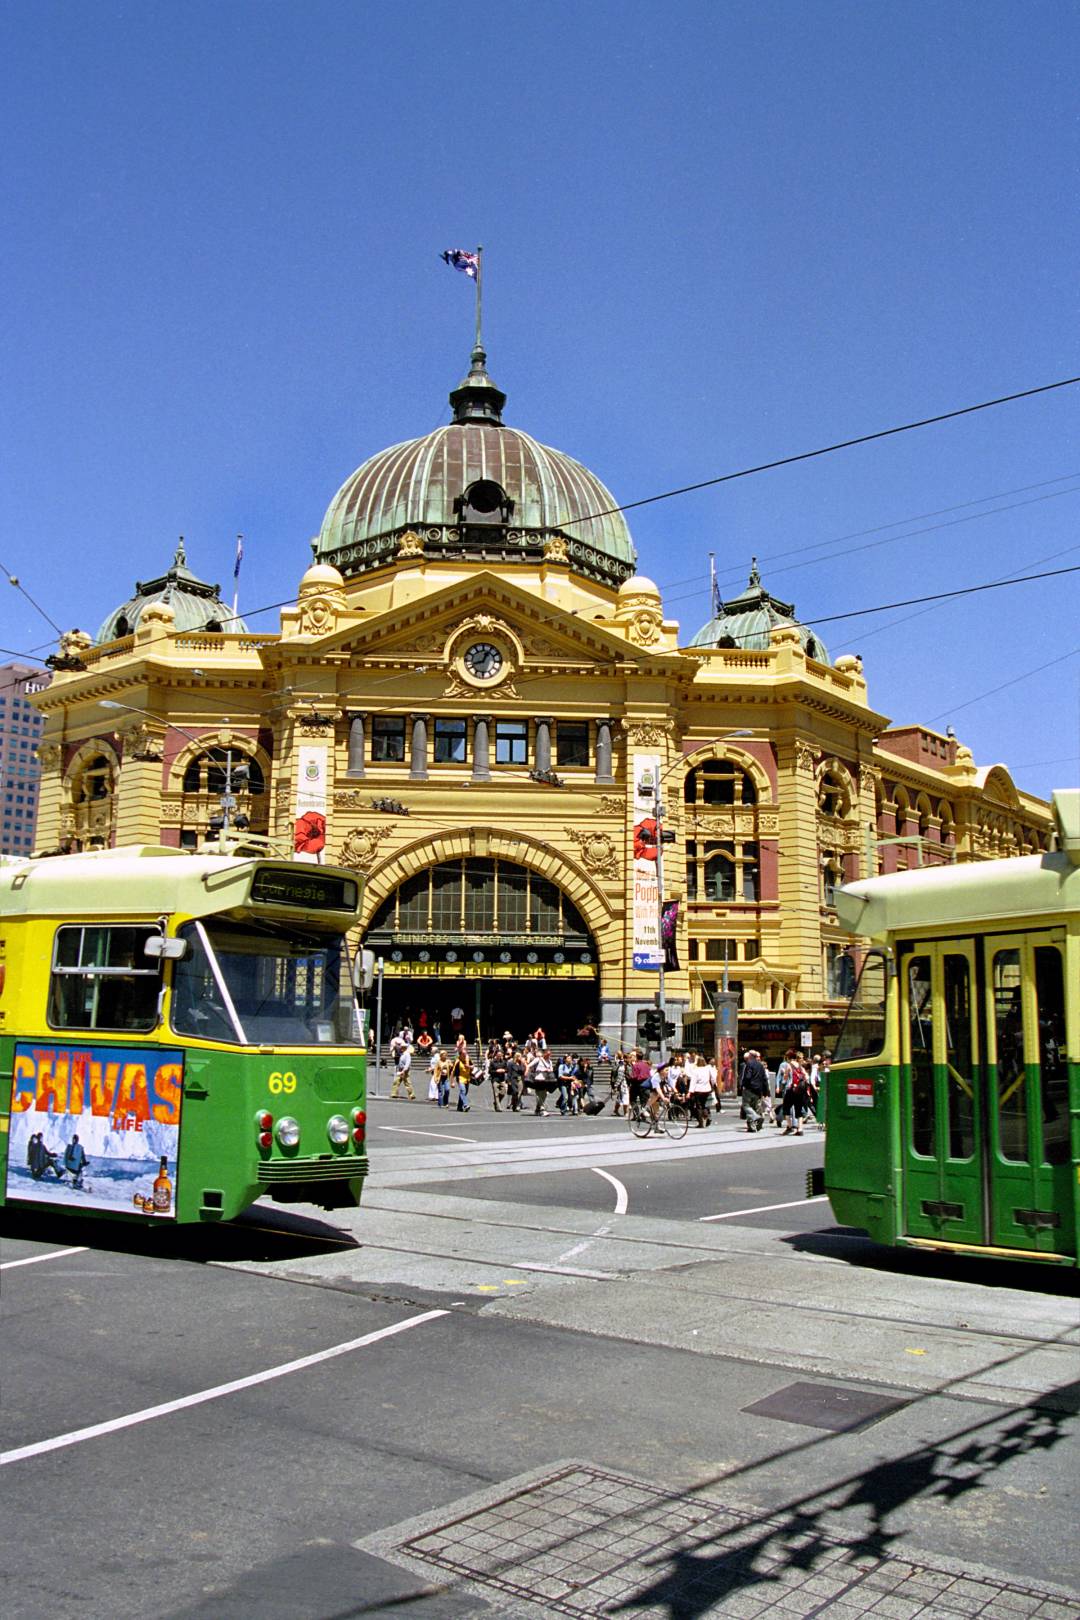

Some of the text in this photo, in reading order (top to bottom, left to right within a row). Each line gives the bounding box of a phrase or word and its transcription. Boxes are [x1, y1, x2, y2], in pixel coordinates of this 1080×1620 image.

[635, 883, 658, 903] Popp
[635, 936, 658, 945] Novemb
[10, 1055, 183, 1125] CHIVAS
[269, 1071, 297, 1094] 69
[113, 1118, 143, 1132] LIFE
